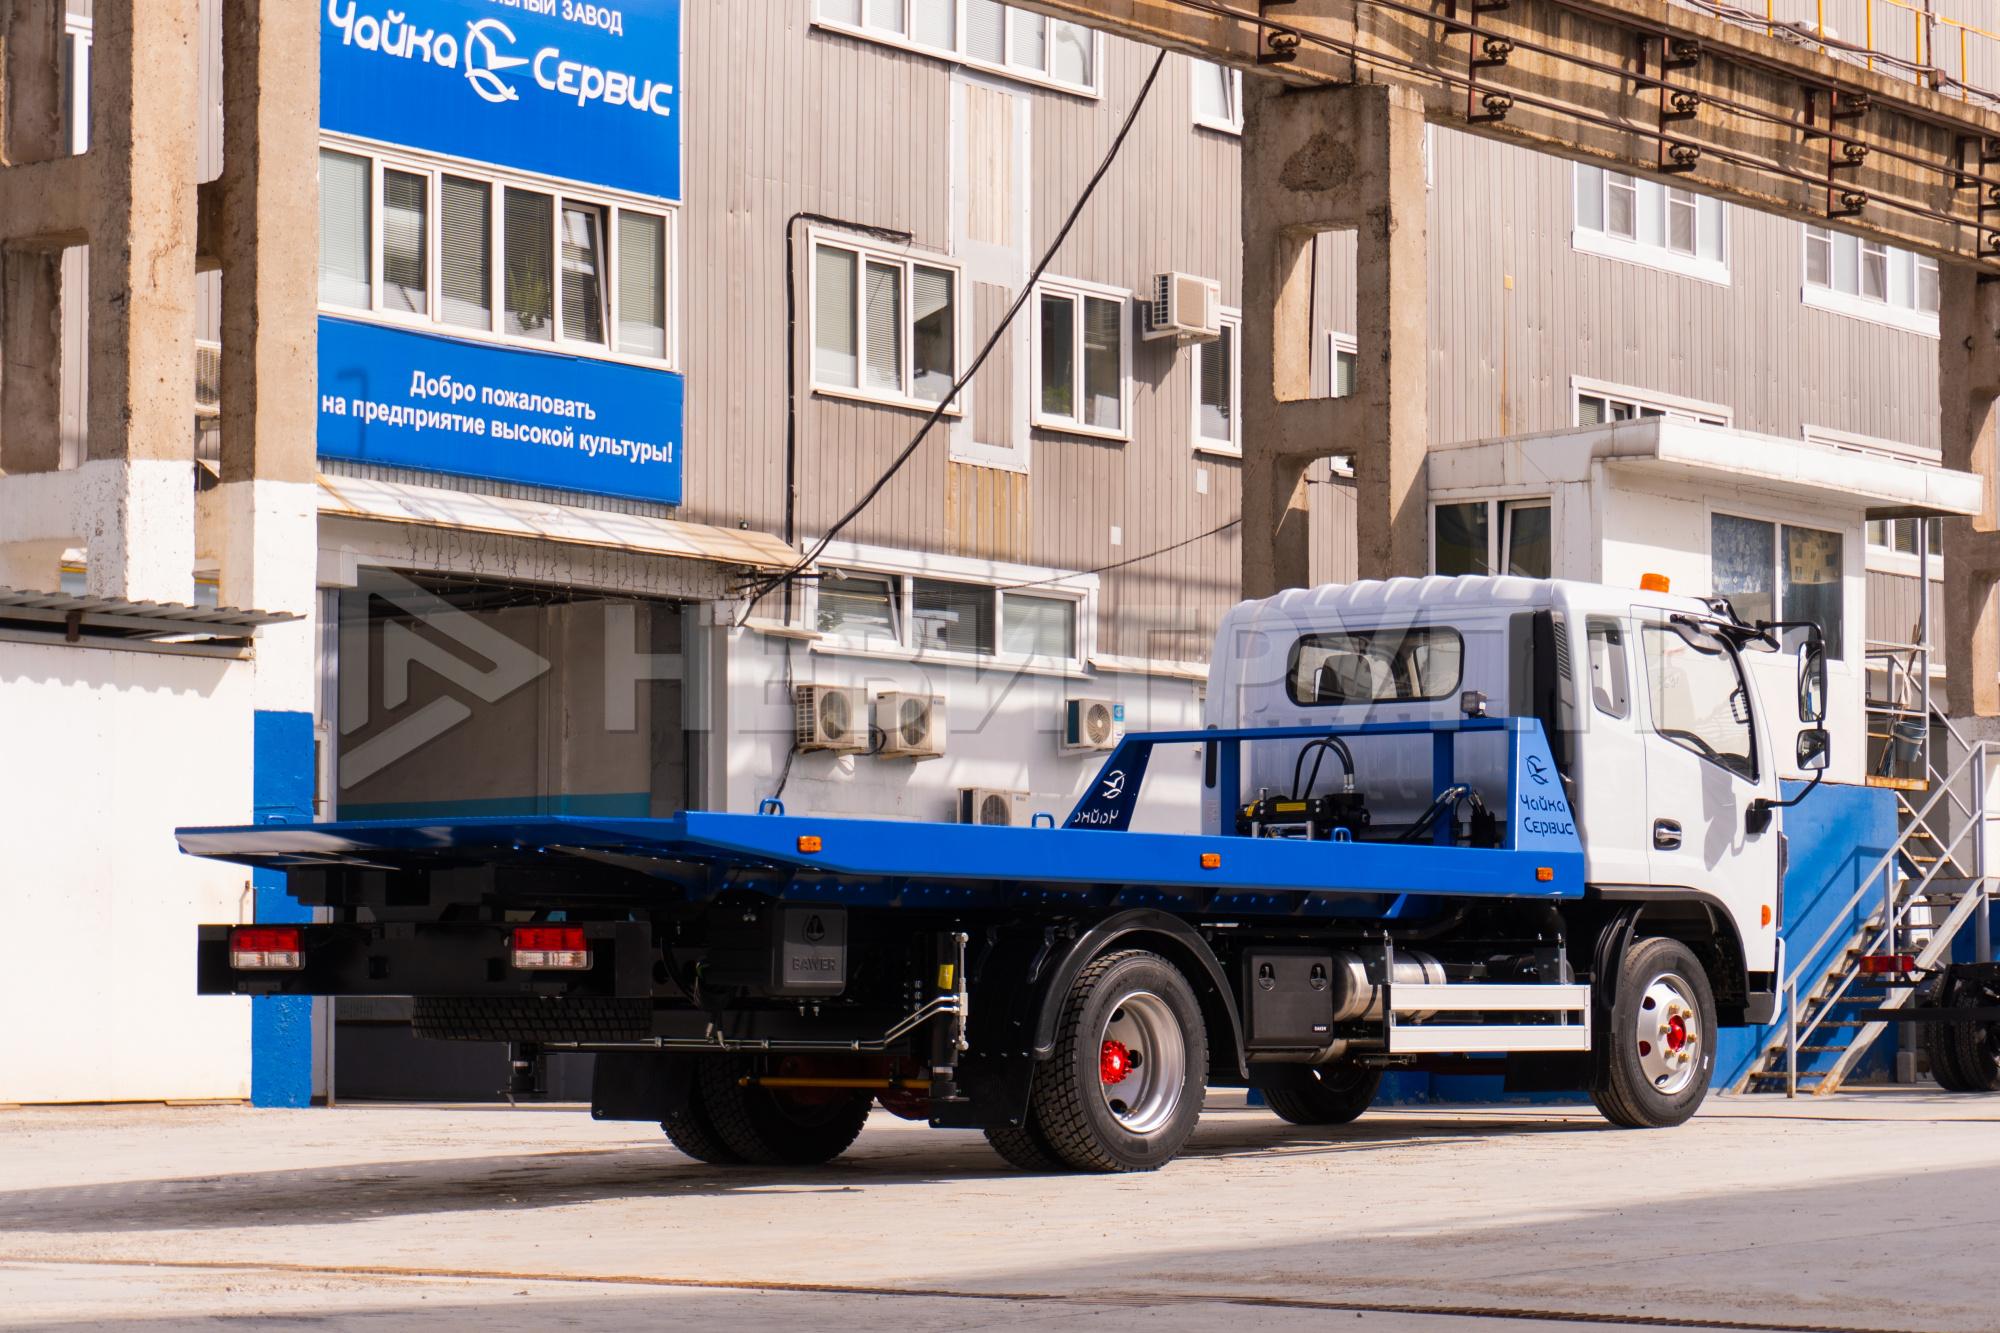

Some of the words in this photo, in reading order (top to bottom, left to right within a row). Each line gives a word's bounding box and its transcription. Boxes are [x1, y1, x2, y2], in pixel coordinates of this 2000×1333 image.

[562, 0, 623, 37] ЗАВОД
[328, 0, 458, 69] Чайка
[533, 47, 673, 116] Сервис
[410, 370, 476, 405] Добро
[482, 387, 596, 421] пожаловать
[321, 395, 347, 416] на
[352, 399, 485, 436] предприятие
[491, 420, 574, 449] высокой
[580, 434, 673, 464] культуры!
[1520, 794, 1566, 812] Чайка
[1524, 816, 1574, 837] Сервис
[792, 957, 836, 971] BAWER
